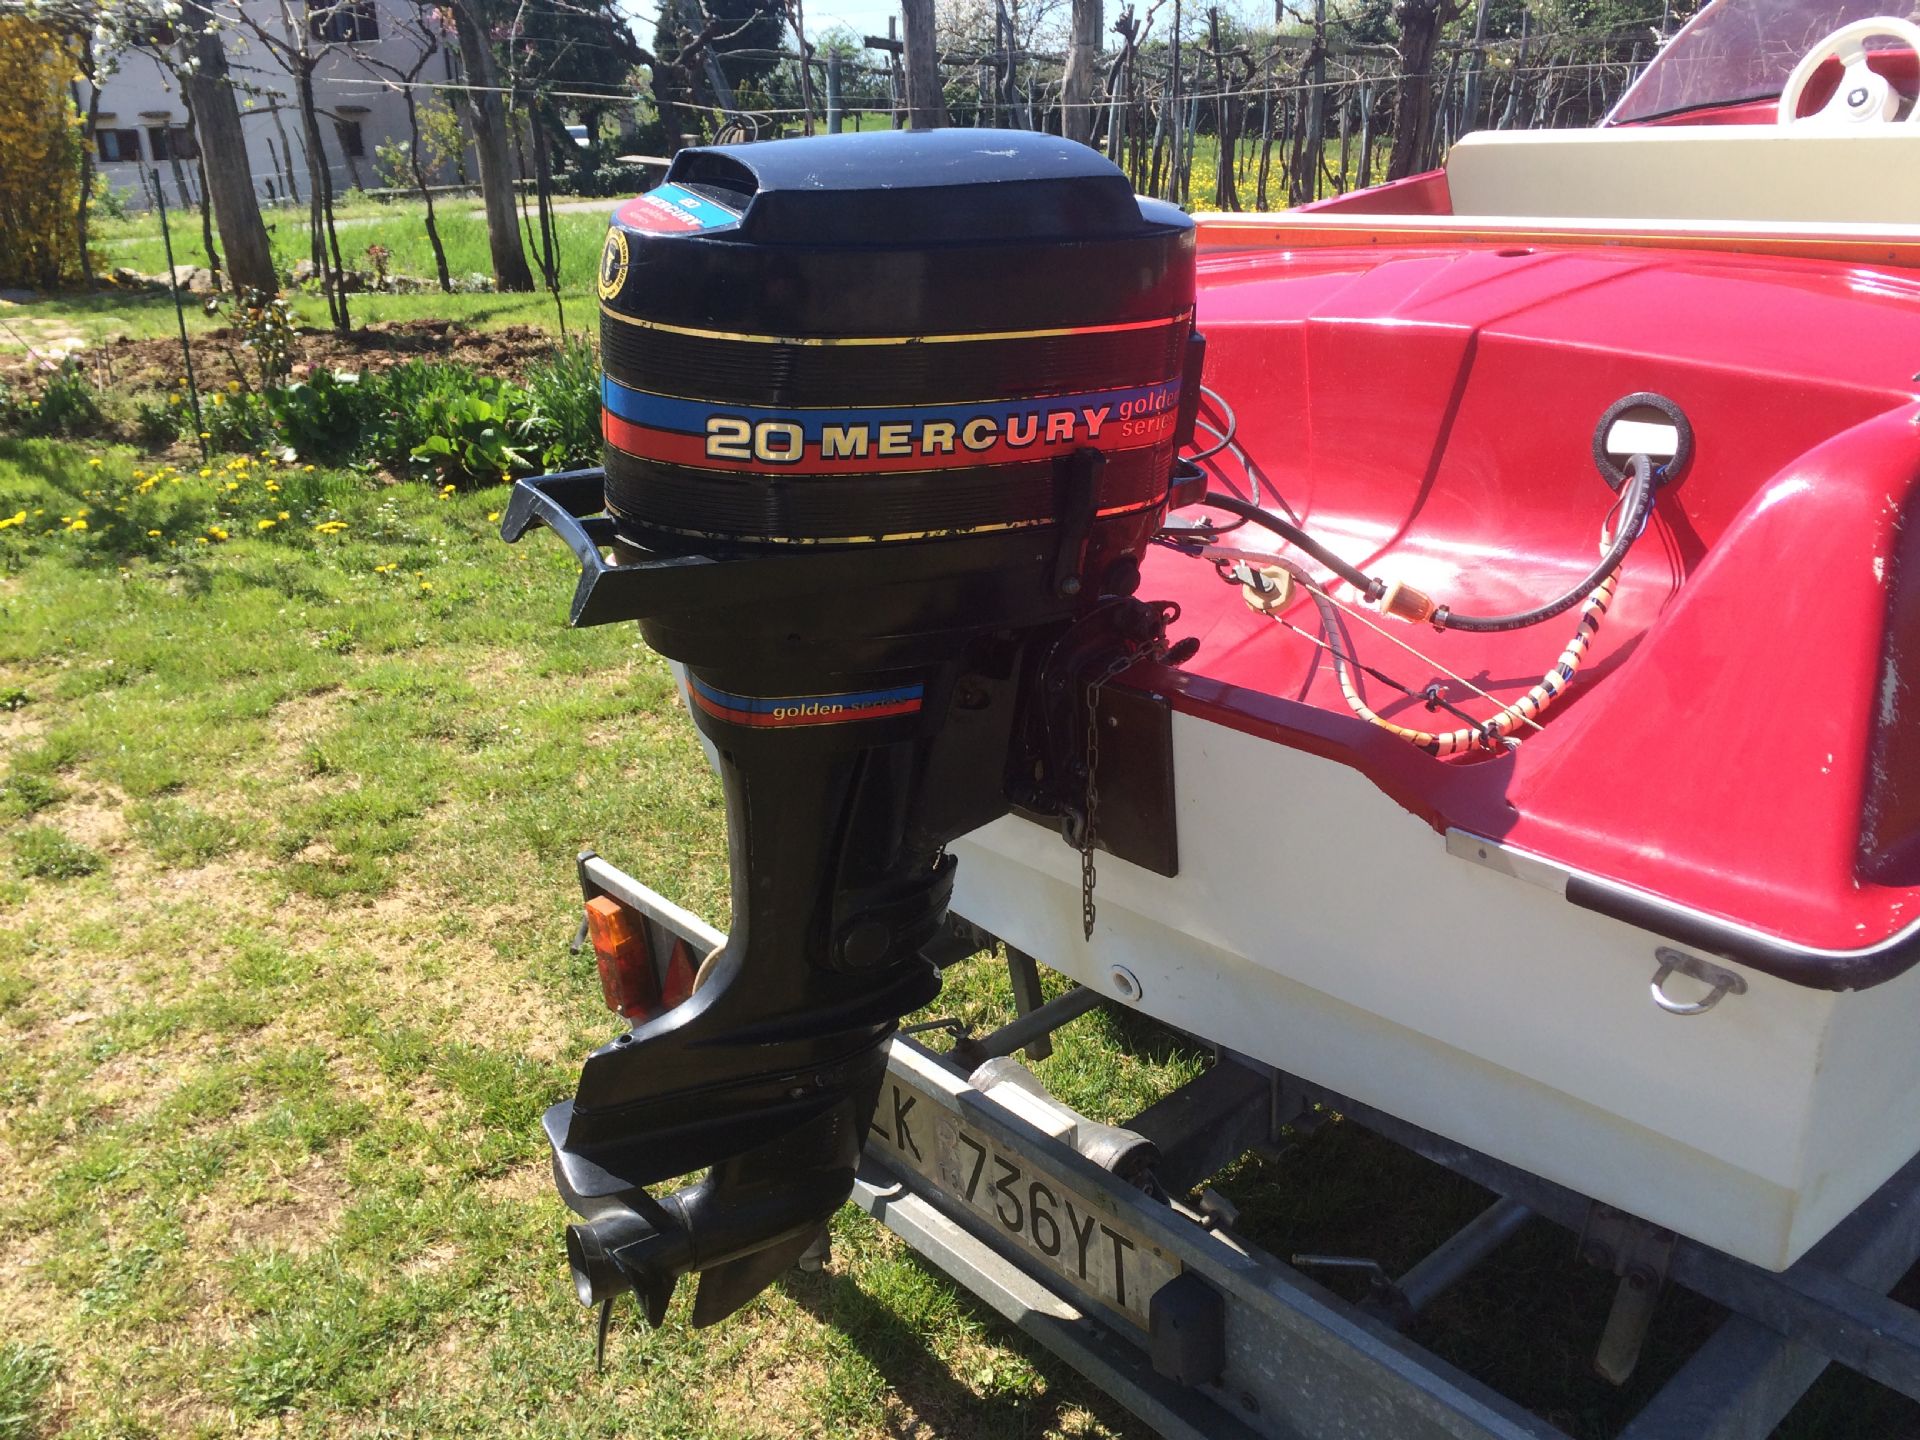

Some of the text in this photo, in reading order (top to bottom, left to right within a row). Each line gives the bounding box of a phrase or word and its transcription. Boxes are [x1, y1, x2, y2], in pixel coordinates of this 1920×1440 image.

[705, 405, 1111, 461] 20 MERCURY
[772, 702, 844, 721] golden
[958, 1130, 1134, 1307] 736YT
